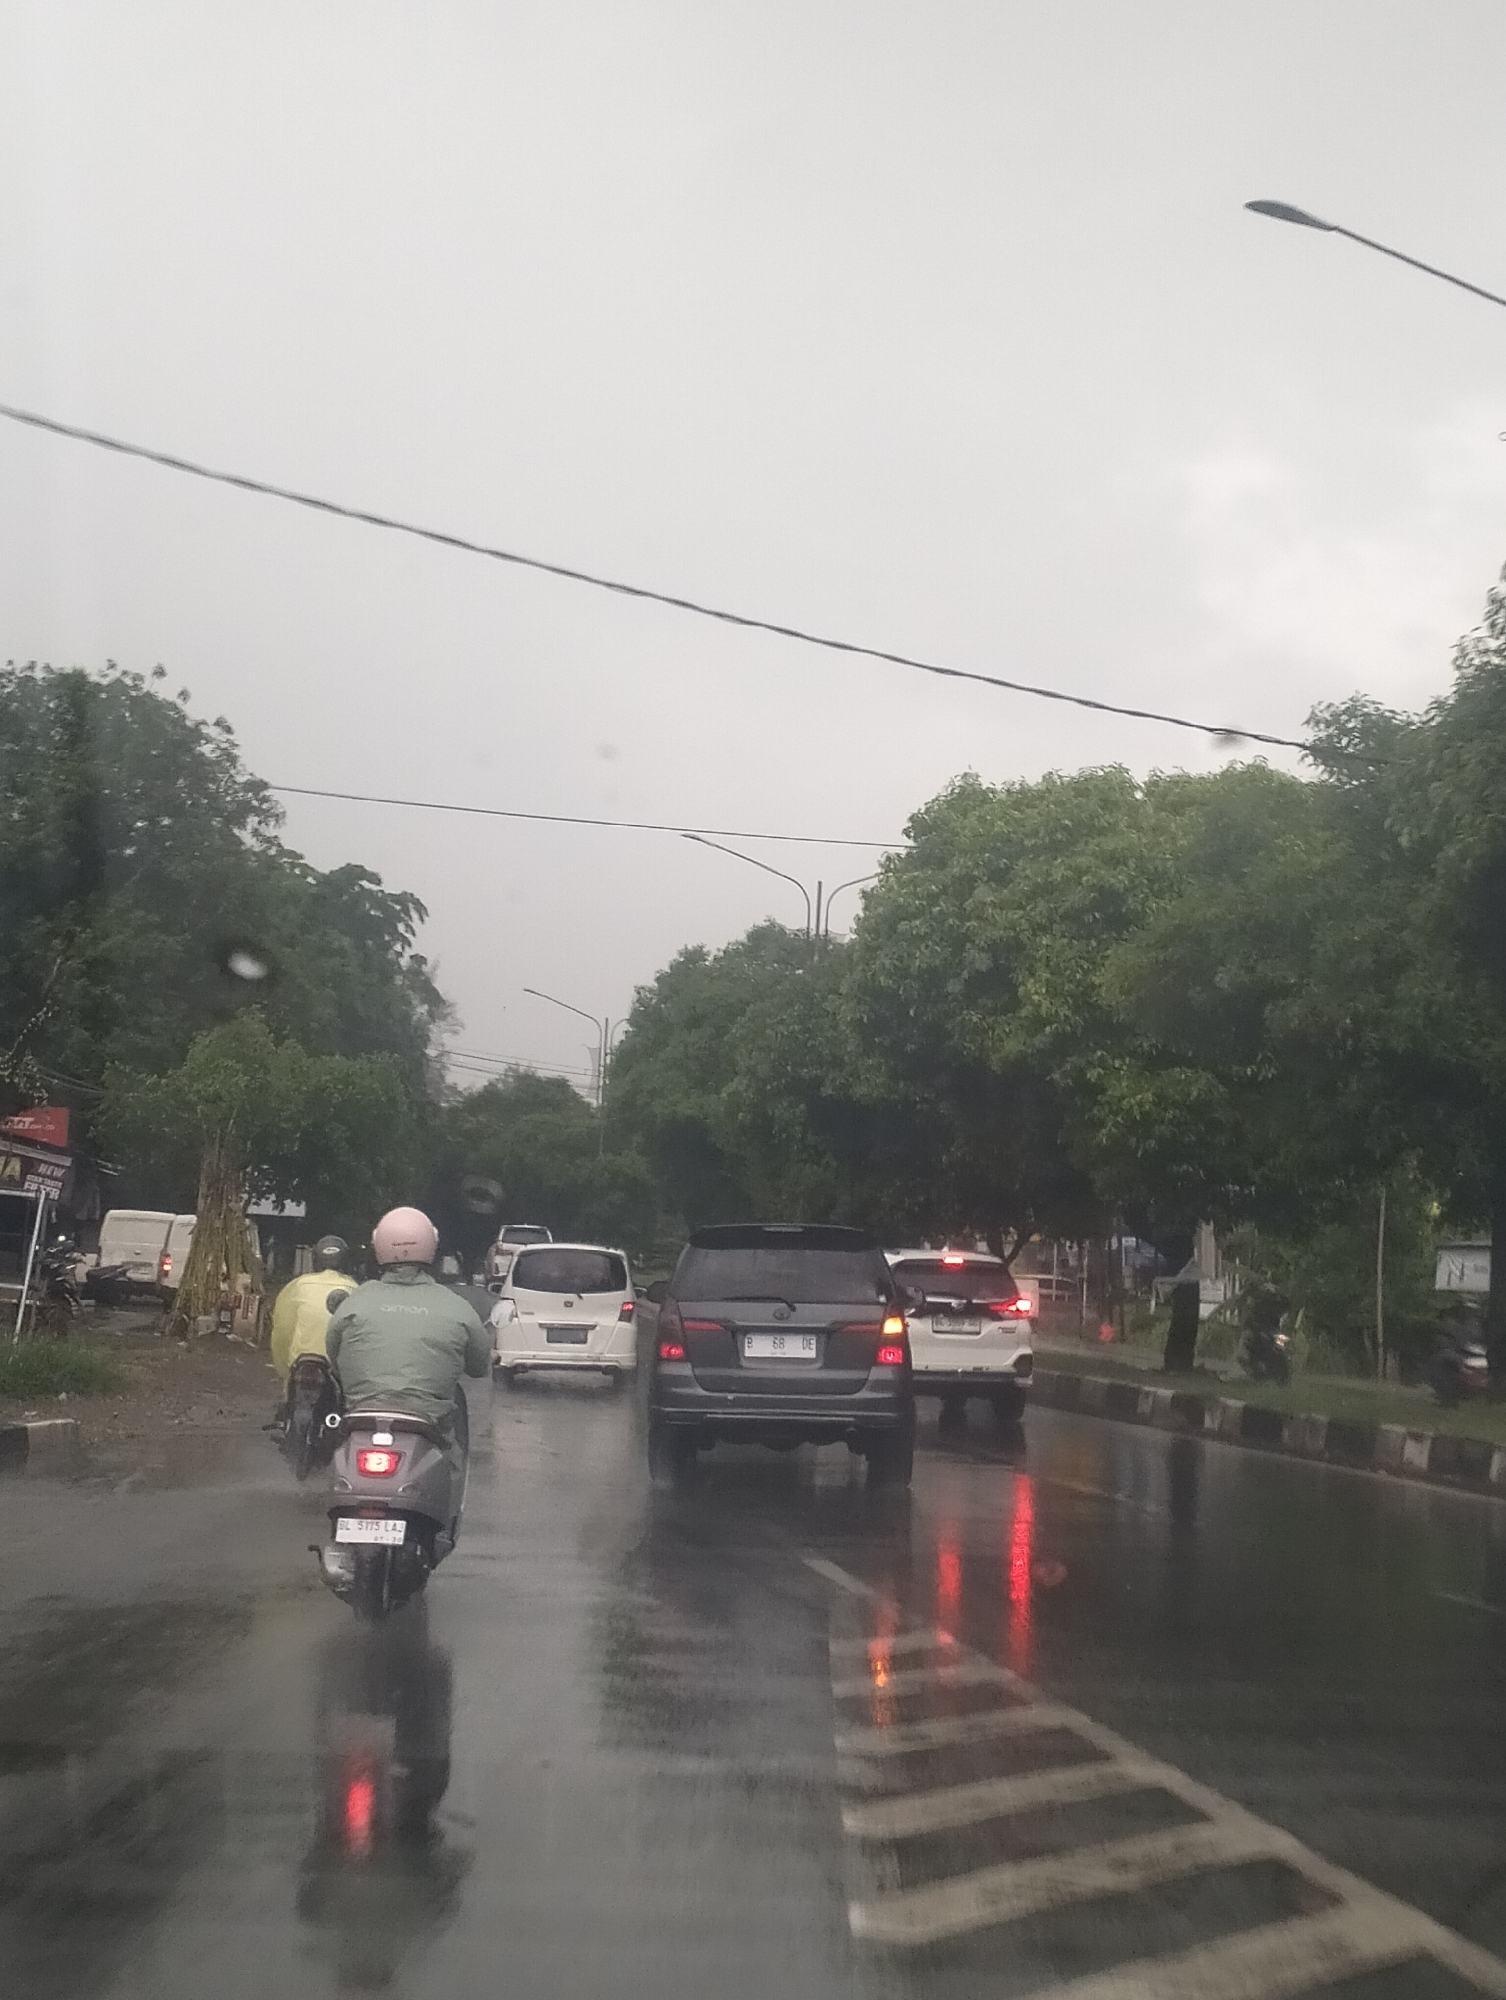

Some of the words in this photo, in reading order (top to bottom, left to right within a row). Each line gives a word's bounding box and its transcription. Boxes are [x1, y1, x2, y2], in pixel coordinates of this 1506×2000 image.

[38, 1162, 66, 1178] NEW
[746, 1337, 753, 1349] B
[802, 1337, 815, 1351] DE
